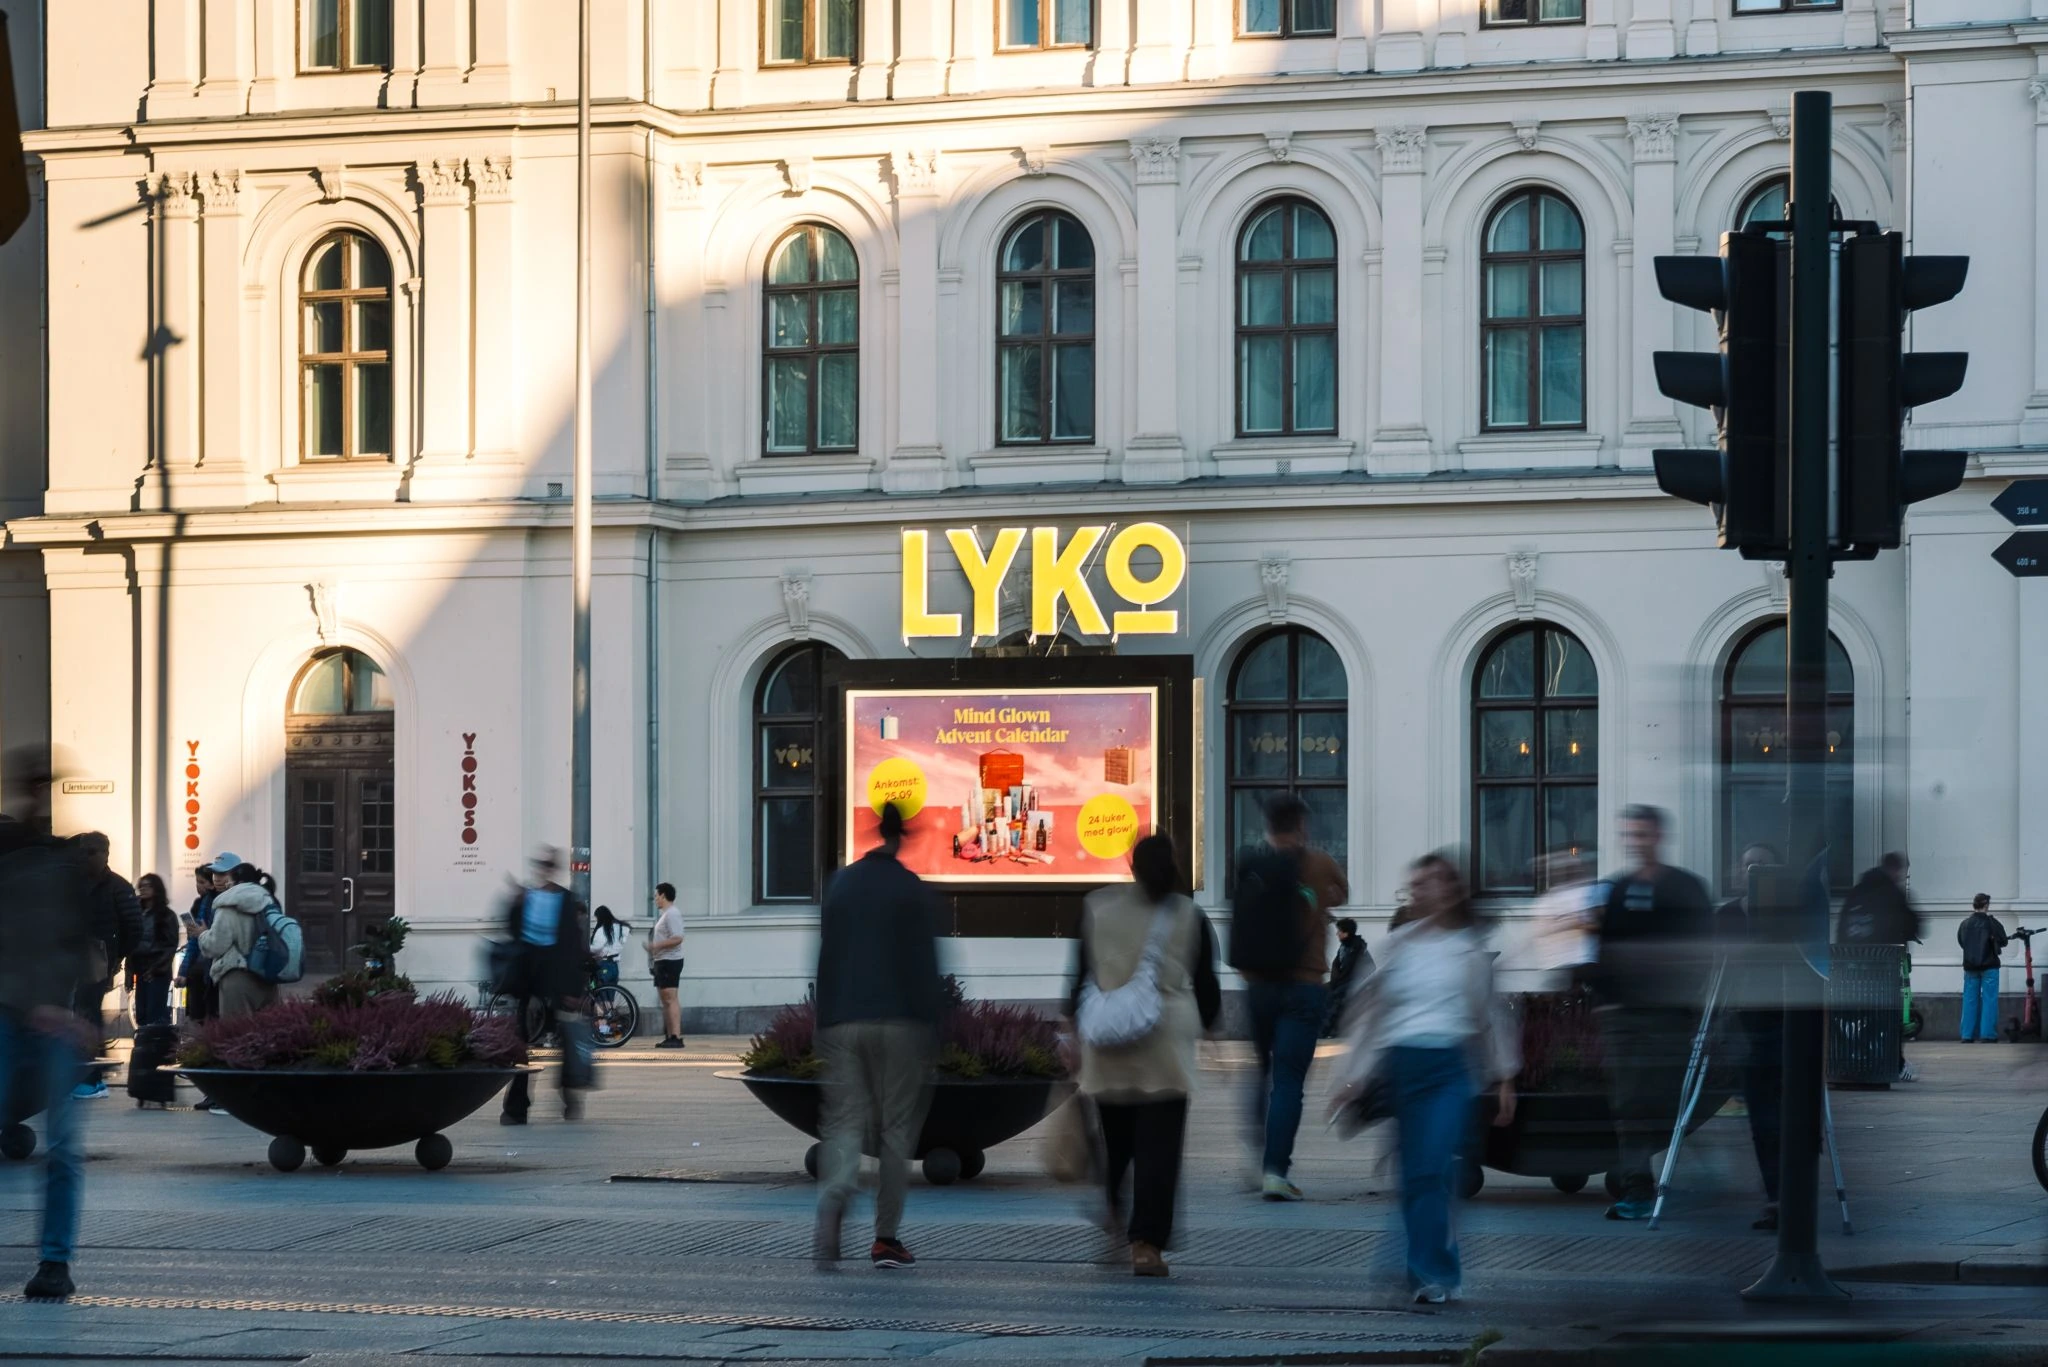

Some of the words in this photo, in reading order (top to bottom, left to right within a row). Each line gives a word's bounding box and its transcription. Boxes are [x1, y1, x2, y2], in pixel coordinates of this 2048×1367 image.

[953, 707, 996, 724] Mind
[998, 707, 1051, 723] Glown
[935, 728, 992, 744] Advent
[994, 727, 1070, 743] Calendar
[873, 777, 920, 790] Ankomst:
[1088, 815, 1100, 825] 24
[1102, 813, 1126, 824] luker
[1083, 828, 1105, 838] med
[1107, 824, 1133, 837] glow!
